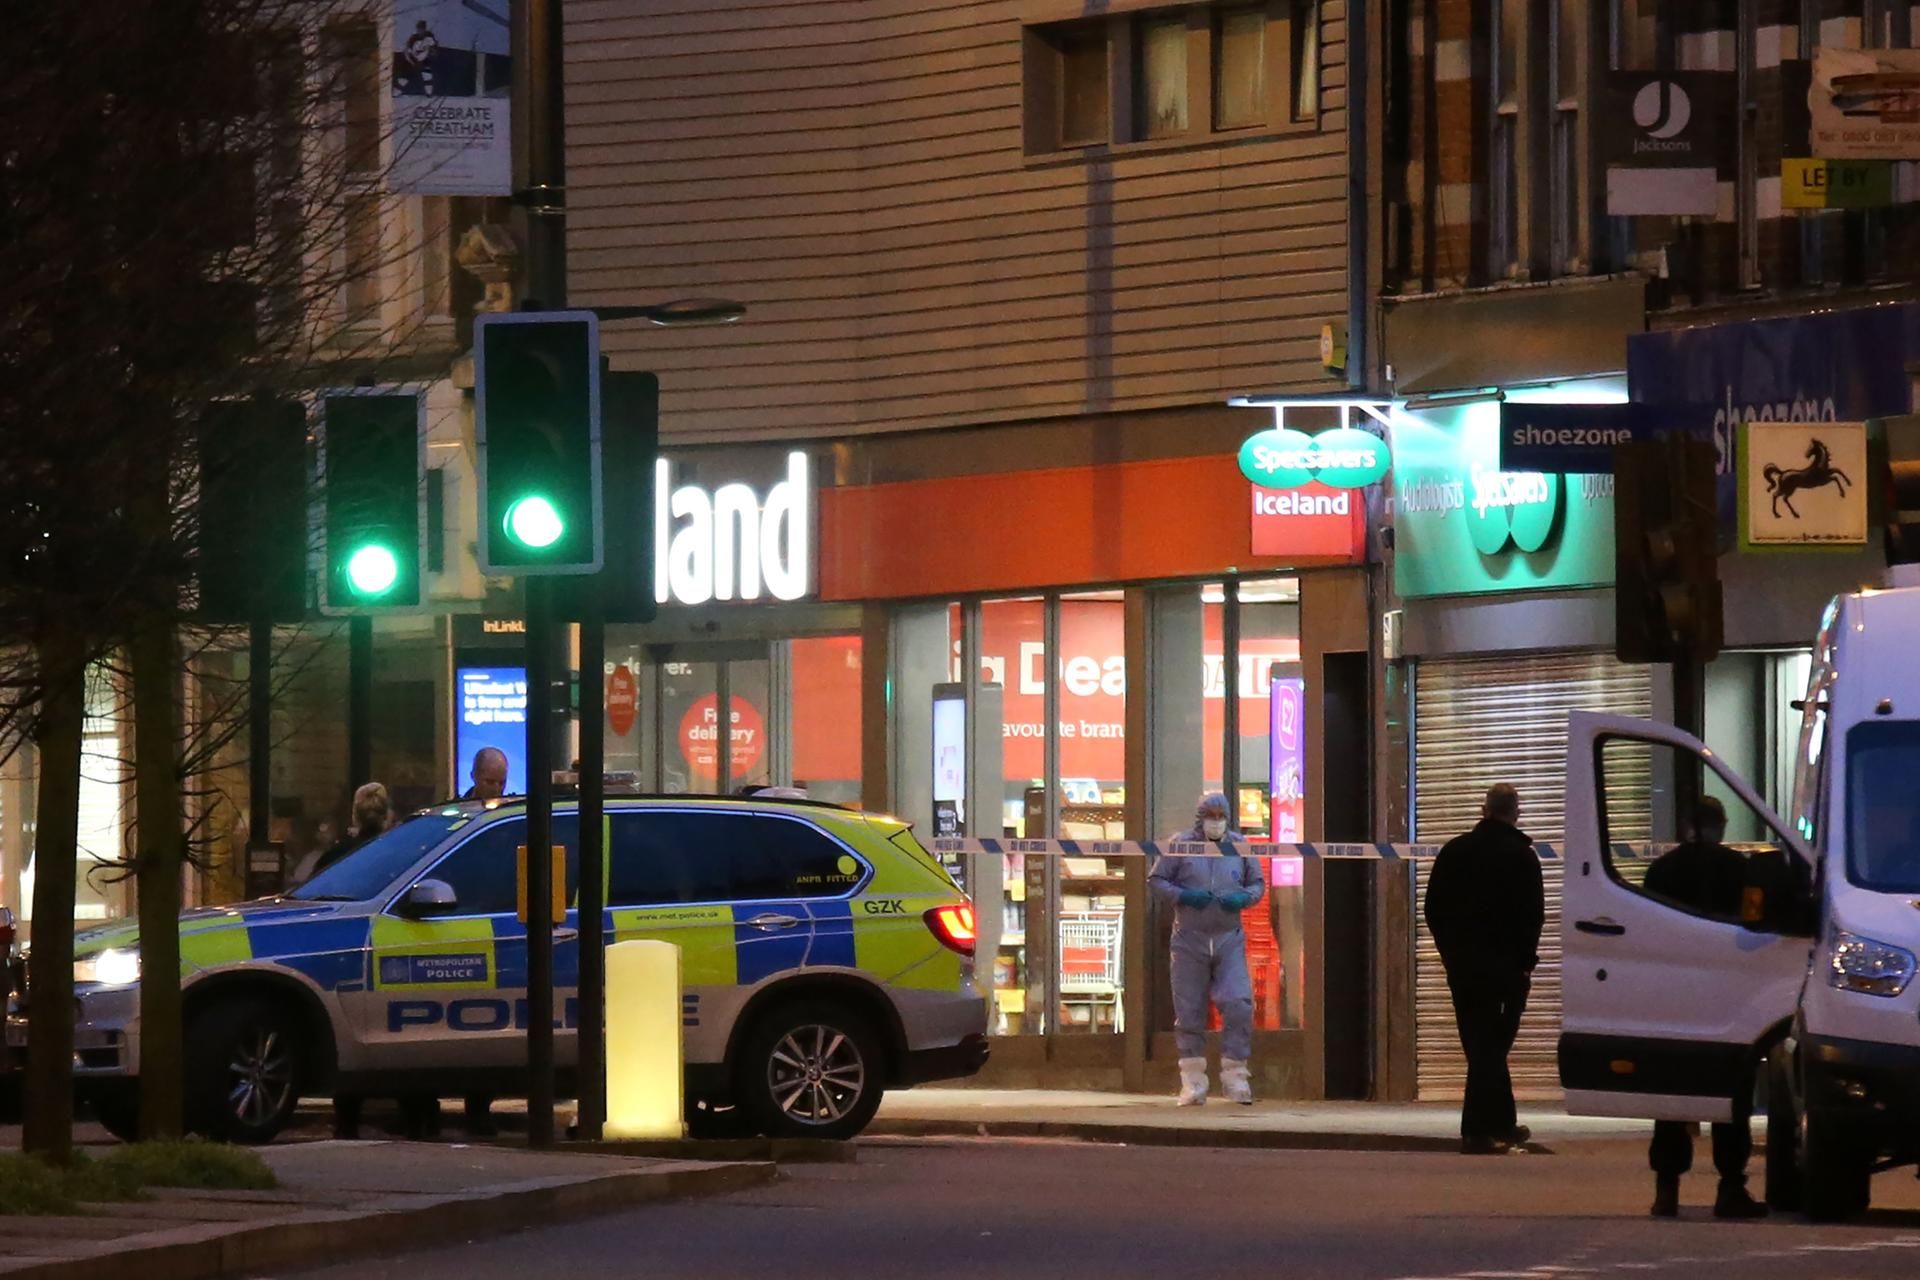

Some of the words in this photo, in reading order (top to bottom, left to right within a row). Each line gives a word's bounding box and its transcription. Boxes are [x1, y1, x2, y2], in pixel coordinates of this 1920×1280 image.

[415, 107, 491, 120] CELEBRATE
[409, 121, 494, 135] STREATHAM
[1633, 138, 1690, 153] Jacksons
[1802, 168, 1834, 188] LET
[1842, 168, 1868, 187] BY
[1513, 424, 1632, 446] shoezone
[1253, 446, 1376, 474] Specsavers
[1471, 463, 1548, 519] Specsavers
[1255, 491, 1349, 515] Iceland
[477, 695, 502, 709] free
[464, 710, 493, 725] right
[796, 875, 822, 884] ANPR
[827, 874, 859, 883] FITTED
[864, 900, 906, 915] GZK
[416, 957, 482, 968] METROPOLITAN
[427, 969, 473, 979] POLICE
